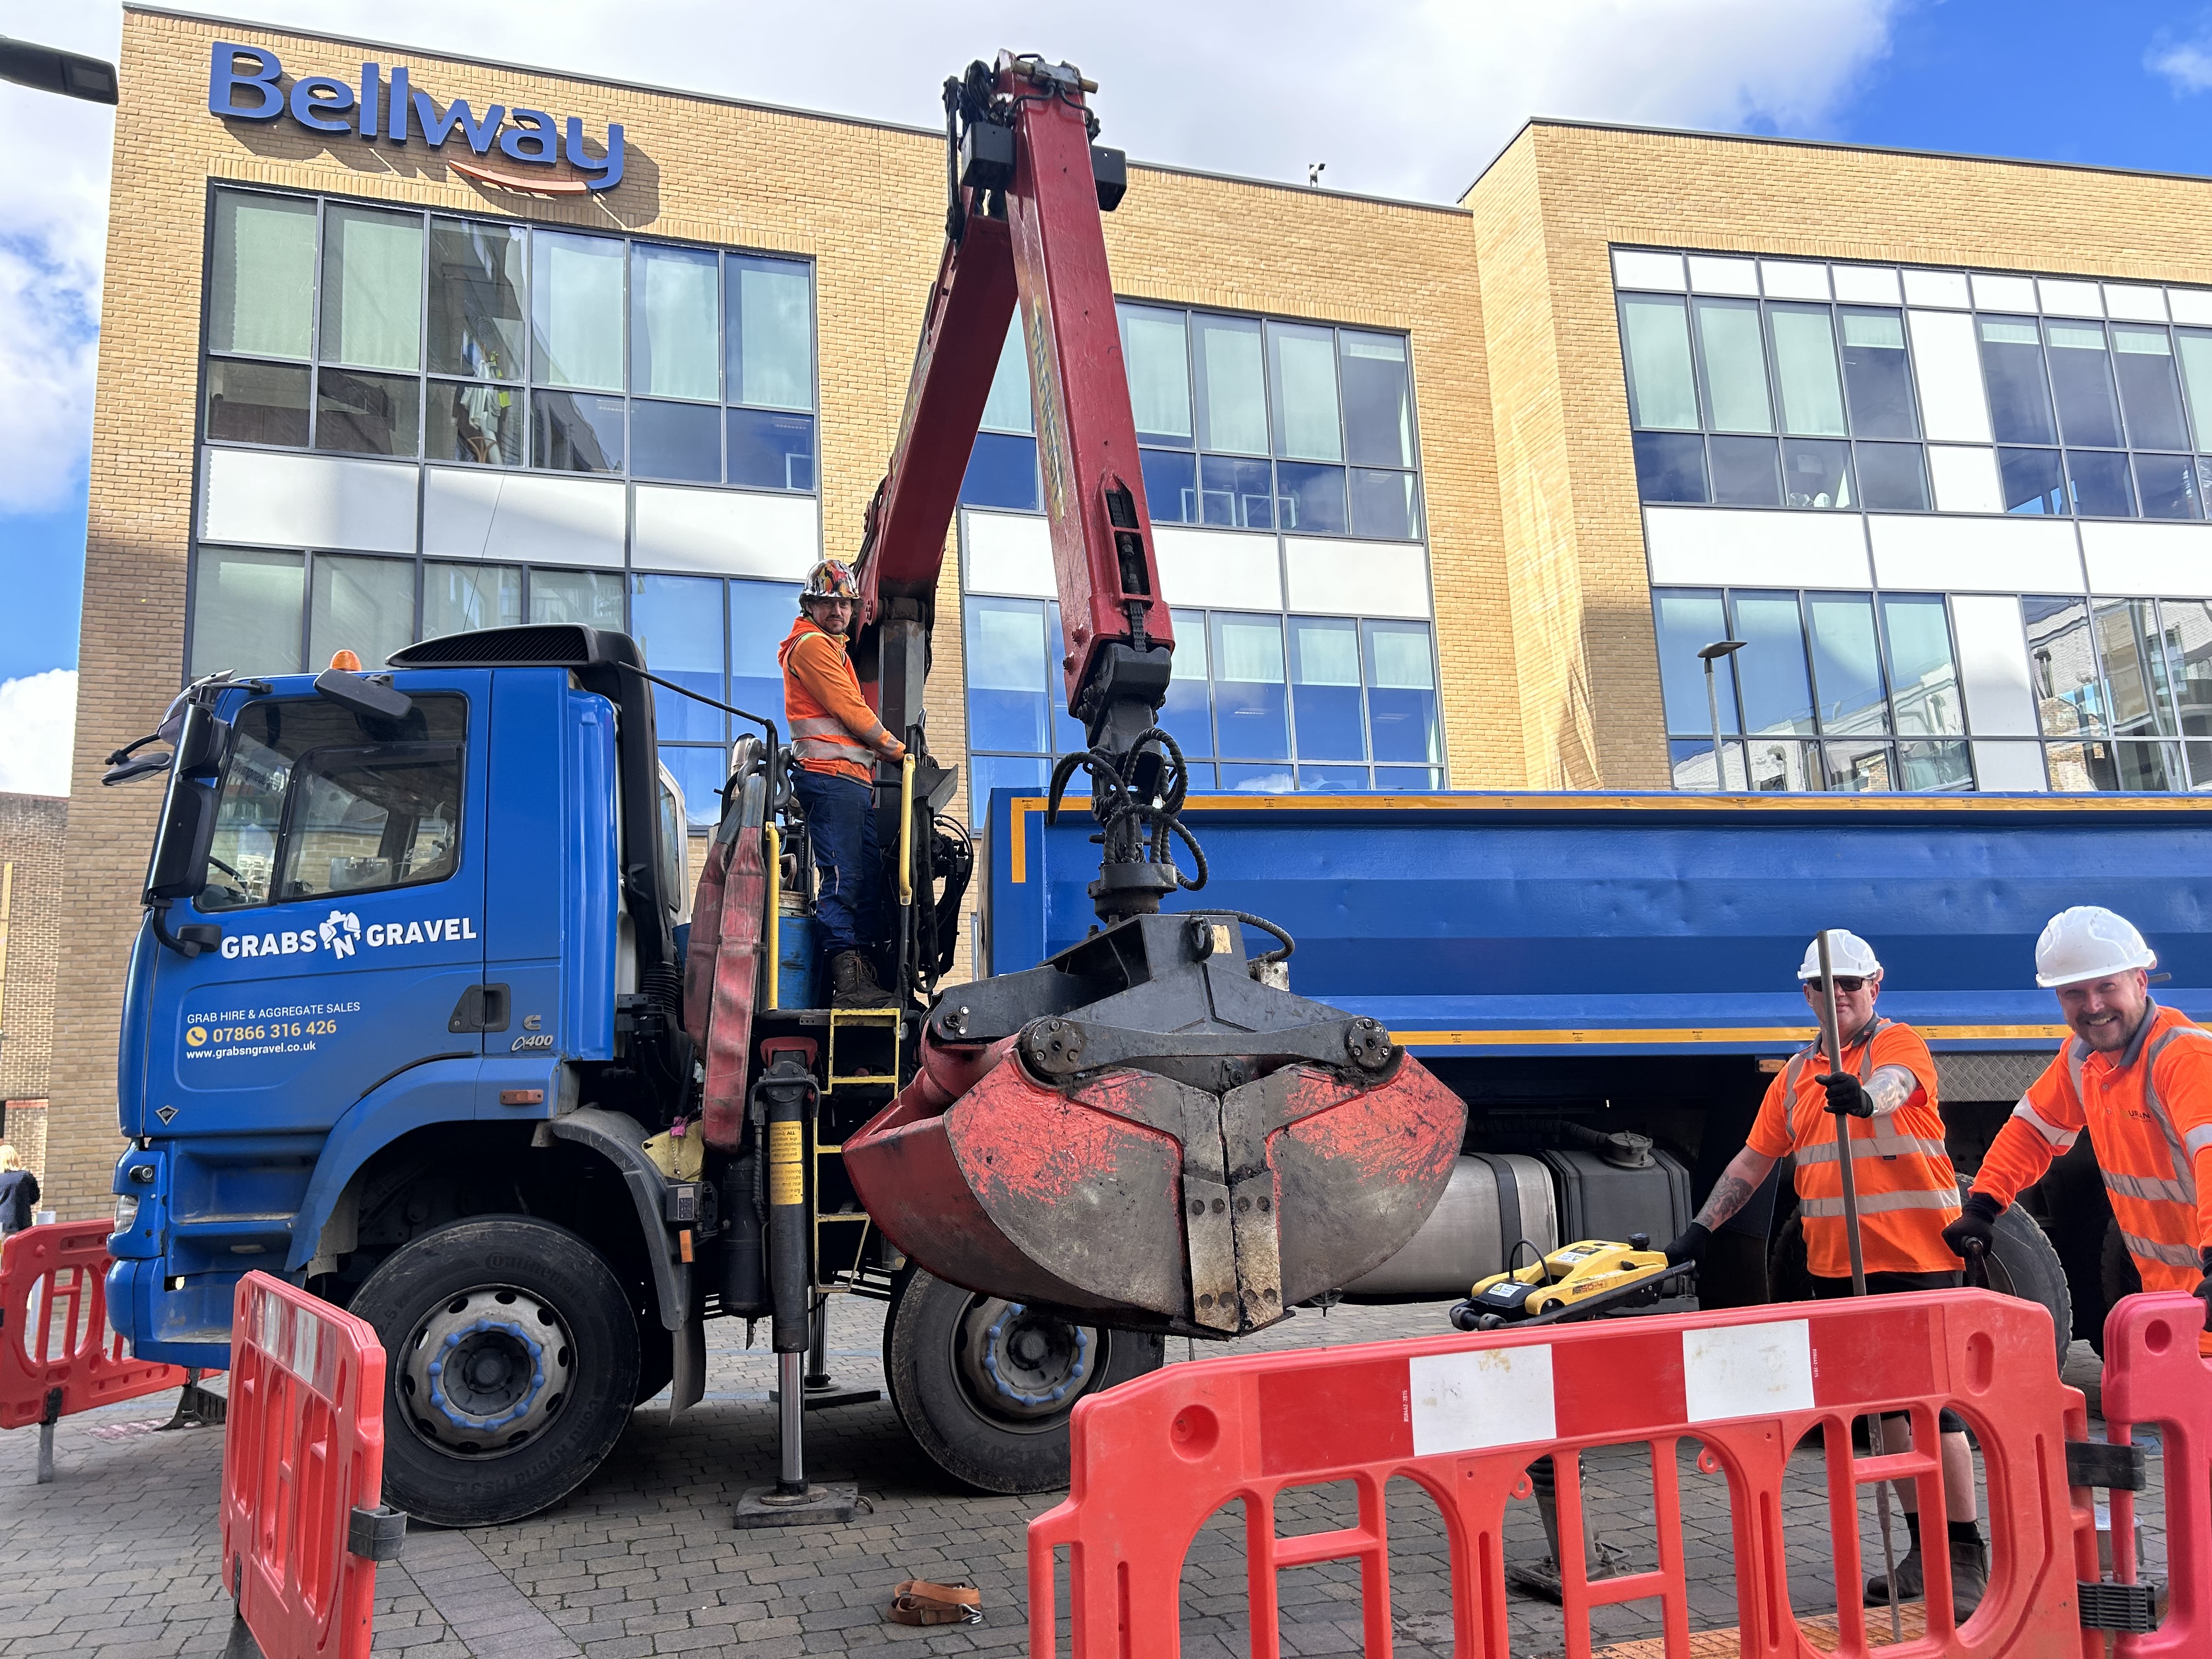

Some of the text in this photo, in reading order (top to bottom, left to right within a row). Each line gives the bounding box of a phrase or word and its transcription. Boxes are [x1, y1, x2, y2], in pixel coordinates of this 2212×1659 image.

[208, 41, 624, 192] Bellway
[221, 929, 317, 960] GRABS
[366, 917, 477, 947] GRAVEL
[187, 1001, 360, 1024] GRAB HIRE & AGGREGATE SALES
[213, 1019, 337, 1043] 07866 316 426
[187, 1040, 317, 1059] www.grabsngravel.co.uk
